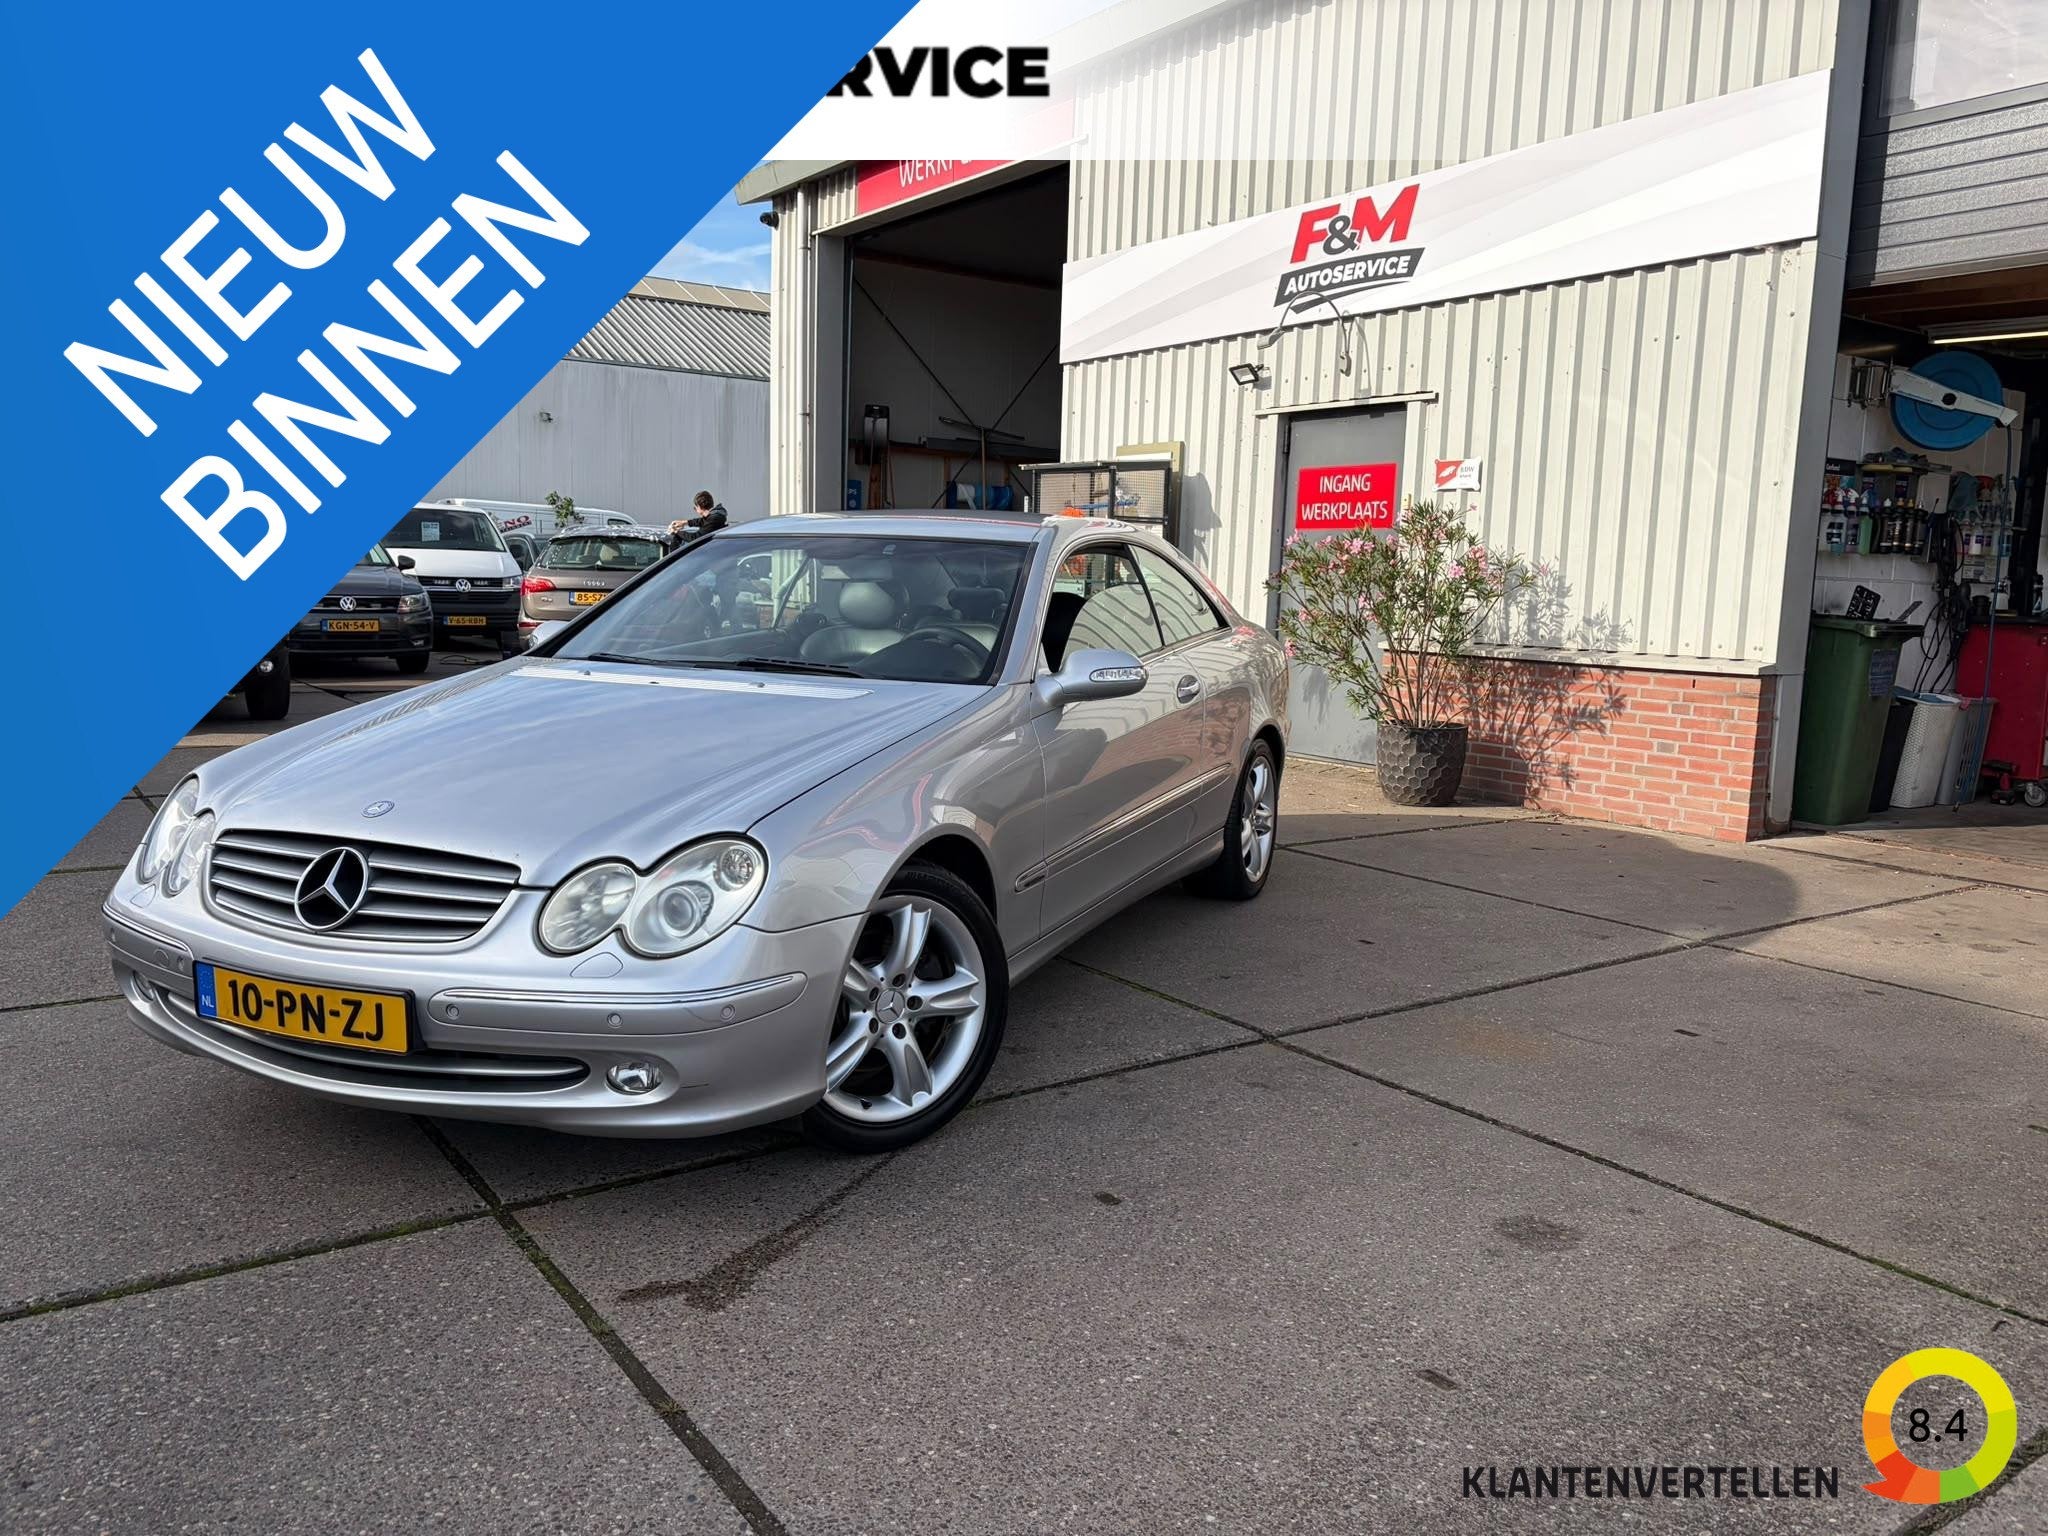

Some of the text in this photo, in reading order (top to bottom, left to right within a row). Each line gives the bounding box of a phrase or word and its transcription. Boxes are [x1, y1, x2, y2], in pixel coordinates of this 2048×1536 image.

[1290, 183, 1420, 264] F&M
[1284, 255, 1412, 296] AUTOSERVICE
[1319, 473, 1371, 494] INGANG
[1301, 500, 1389, 521] WERKPLAATS
[329, 621, 376, 630] KGN-54-V
[201, 994, 215, 1009] NL
[228, 979, 384, 1042] 10-PN-ZJ
